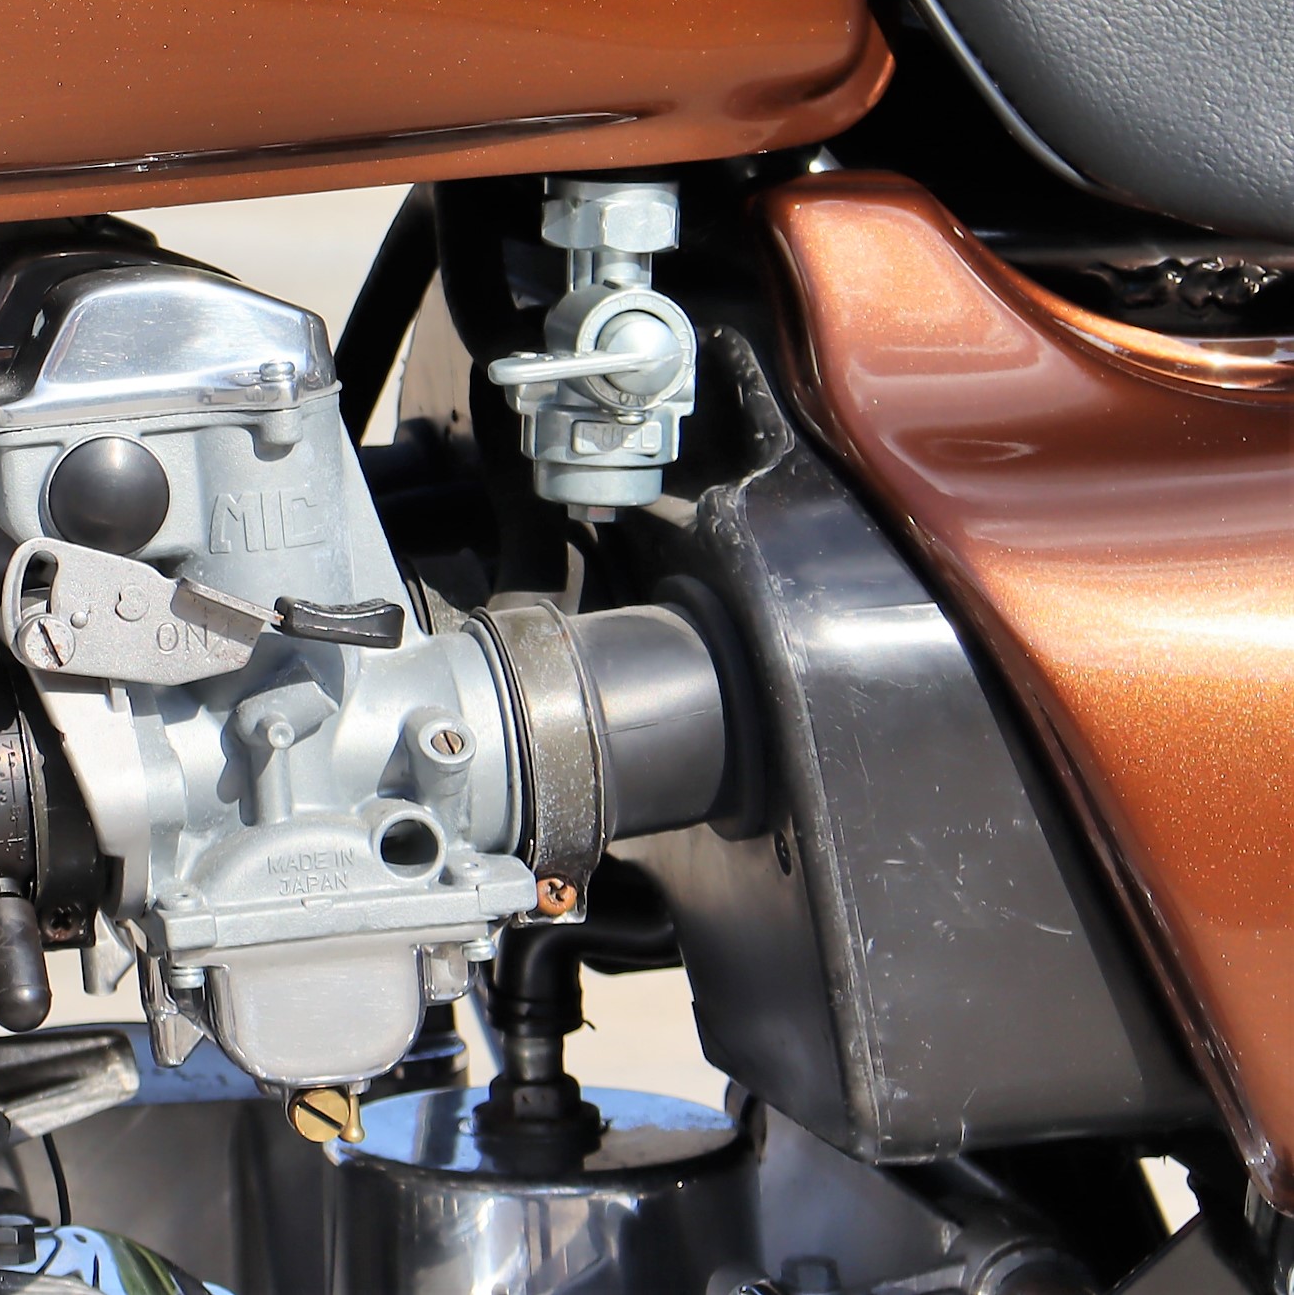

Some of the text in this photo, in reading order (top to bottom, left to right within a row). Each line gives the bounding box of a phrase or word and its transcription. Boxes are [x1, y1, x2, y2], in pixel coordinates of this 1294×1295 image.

[581, 424, 658, 451] FUEL
[156, 621, 210, 654] ON
[267, 848, 355, 875] MADE IN
[279, 870, 348, 896] JAPAN
